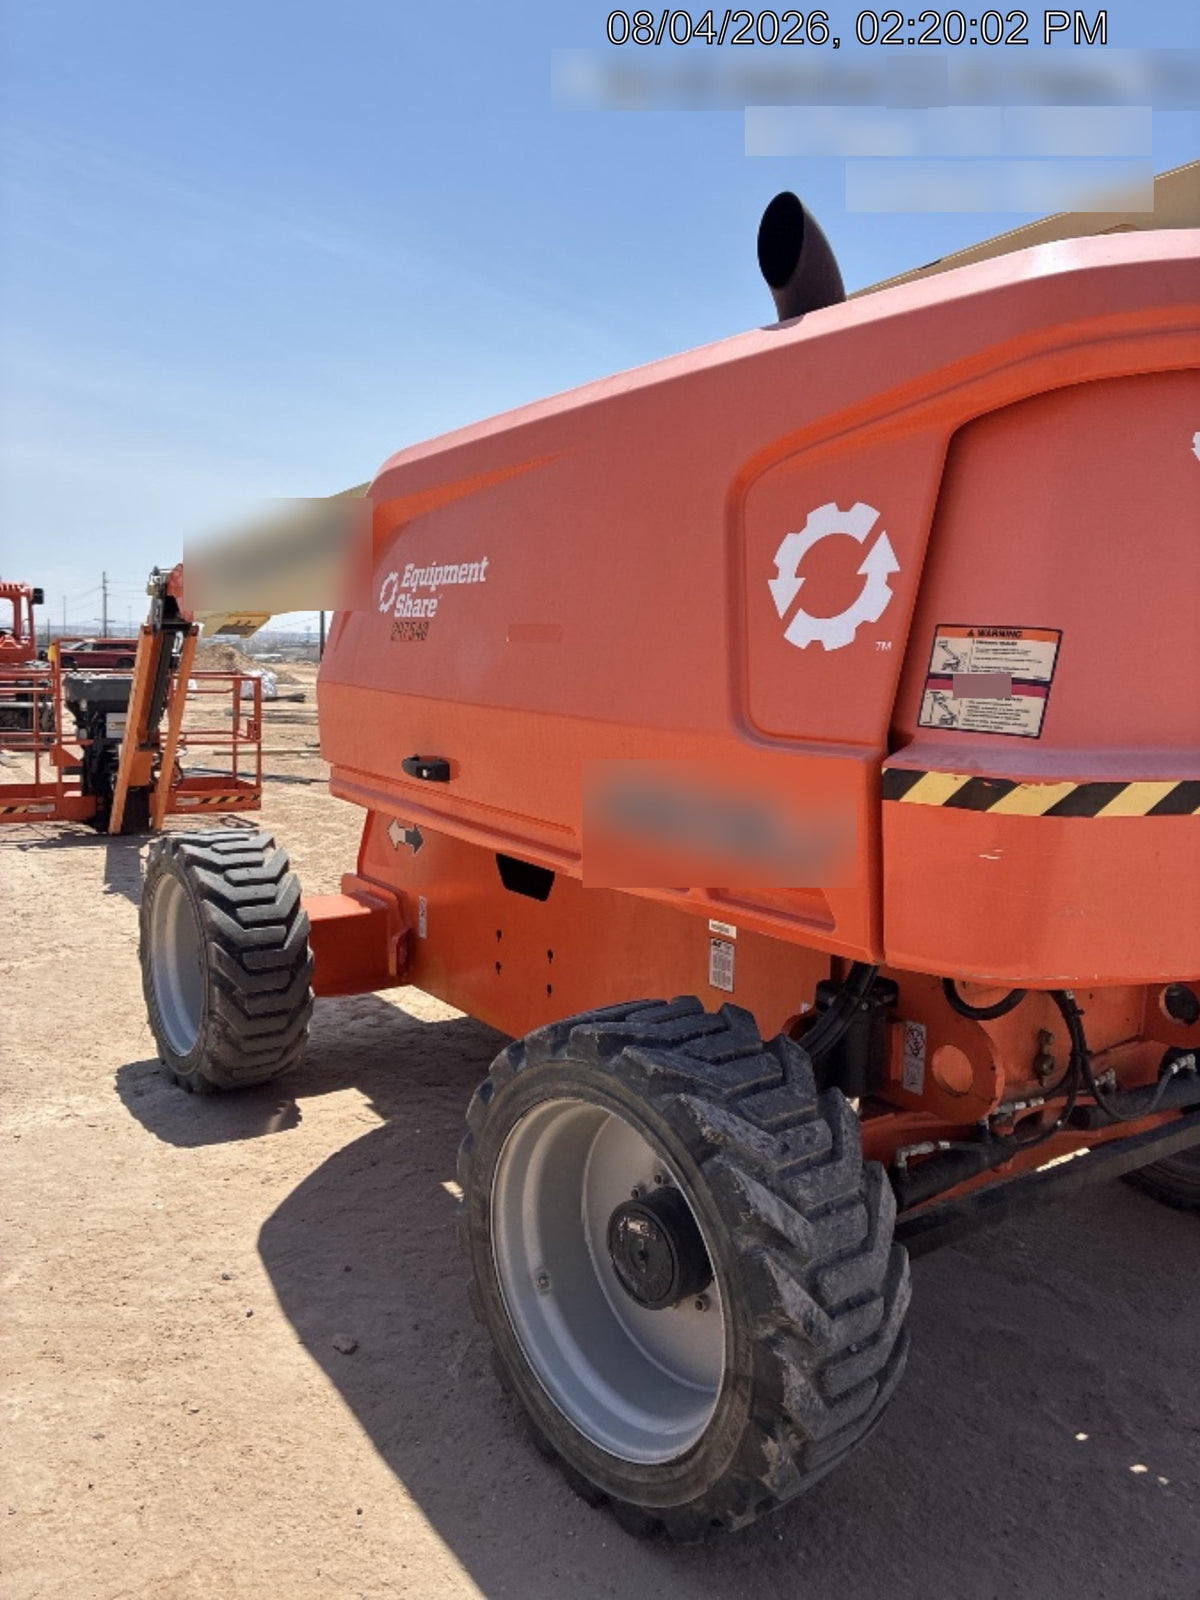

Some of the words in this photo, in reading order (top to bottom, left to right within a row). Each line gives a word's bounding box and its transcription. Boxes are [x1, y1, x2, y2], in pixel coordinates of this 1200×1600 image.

[401, 556, 489, 592] Equipment
[394, 593, 438, 618] Share
[977, 628, 1023, 639] WARNING
